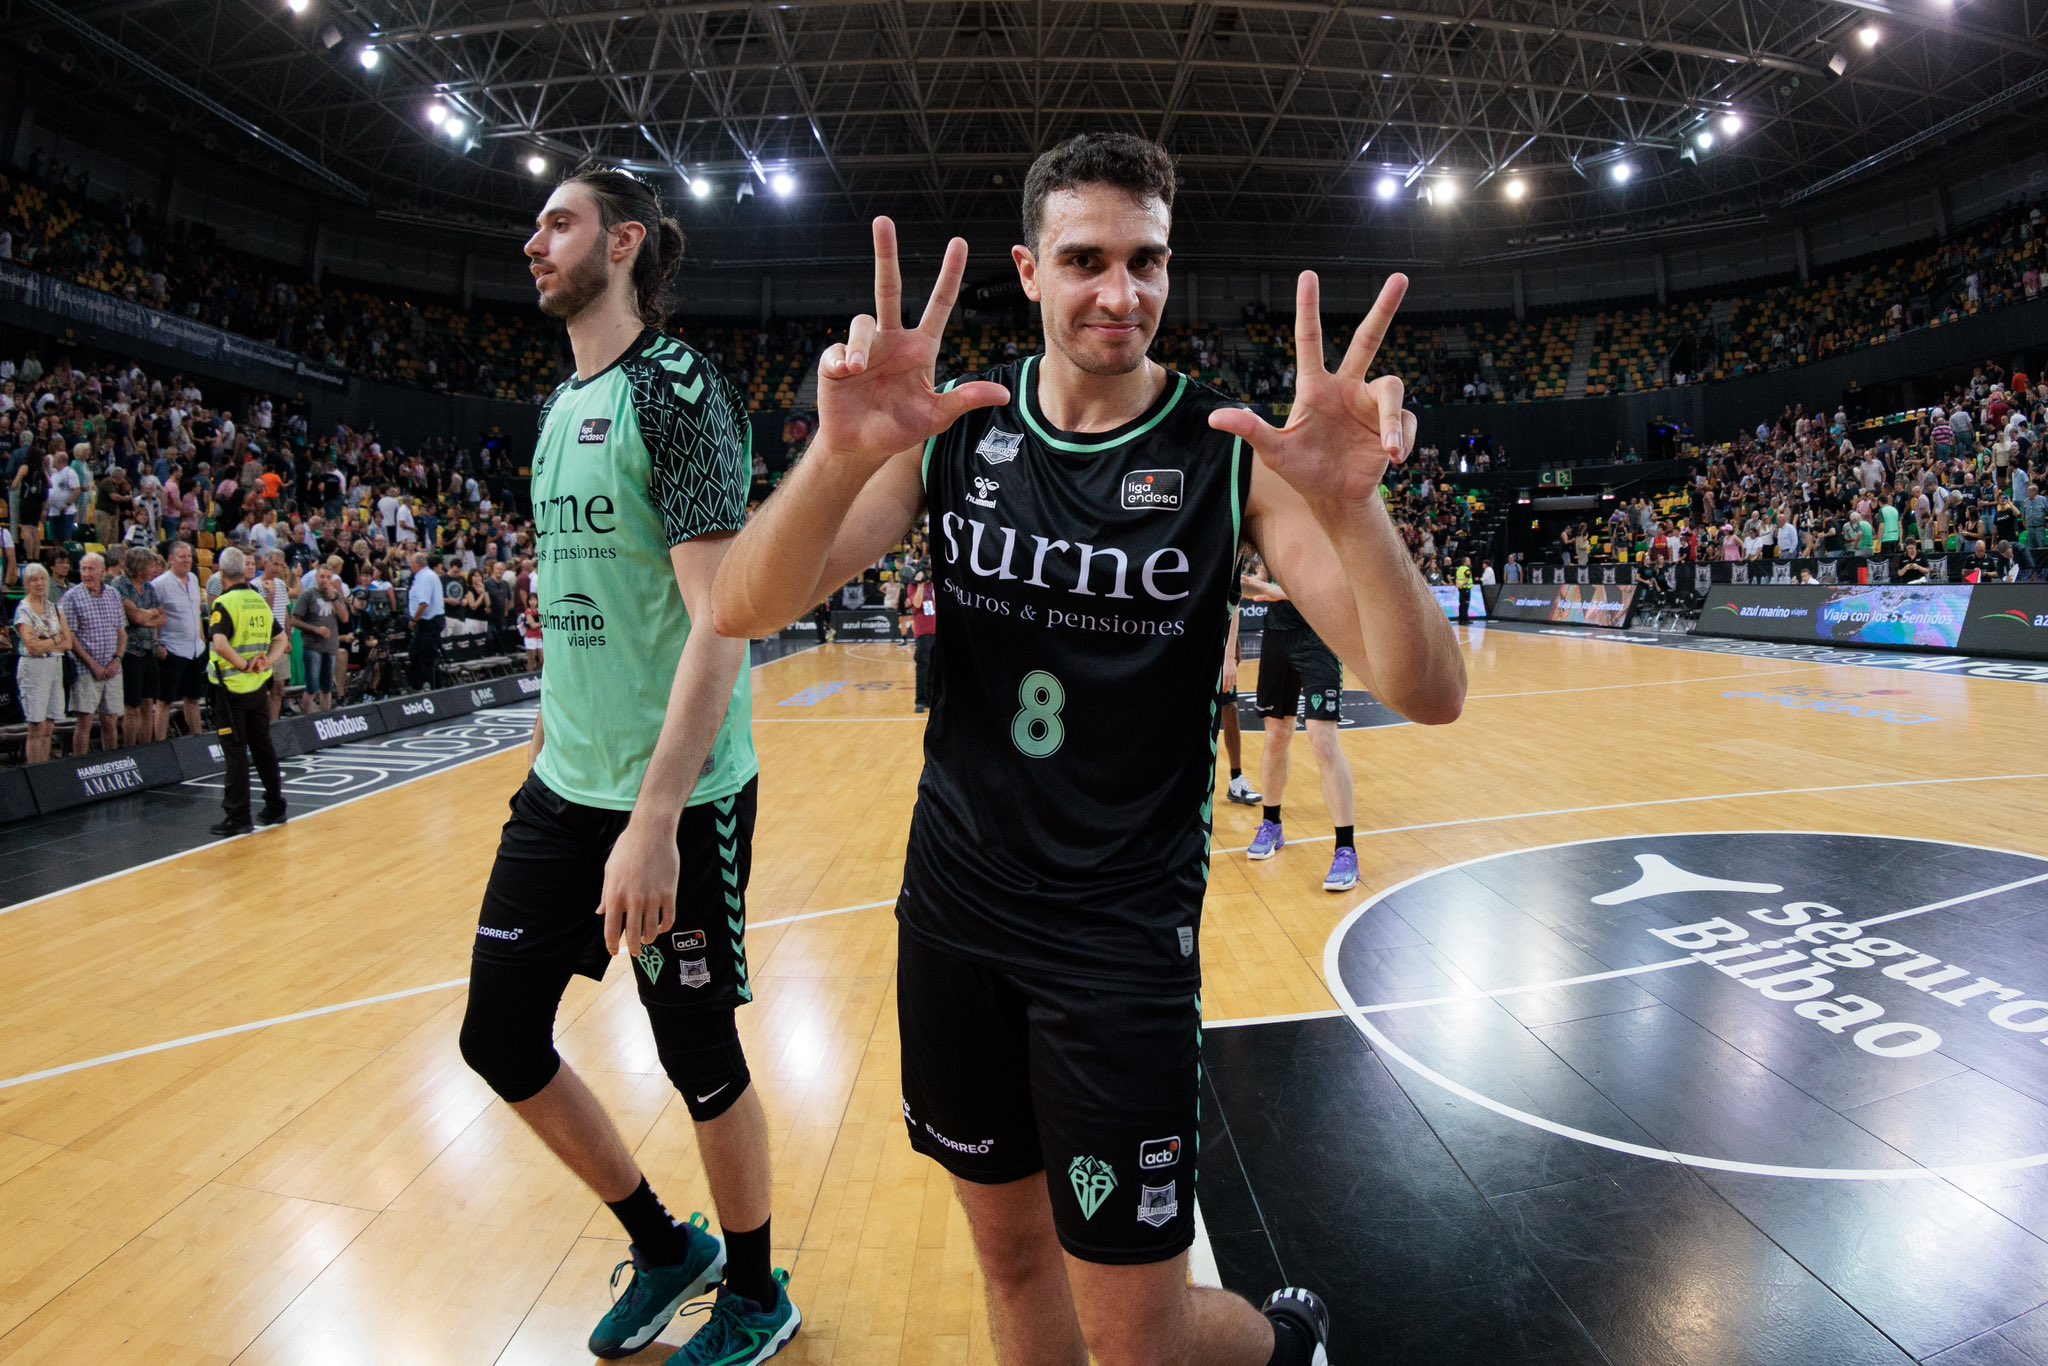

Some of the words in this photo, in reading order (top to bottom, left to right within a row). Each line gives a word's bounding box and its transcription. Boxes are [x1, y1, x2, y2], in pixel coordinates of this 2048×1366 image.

[580, 432, 605, 441] endesa
[1542, 472, 1551, 483] C
[1128, 481, 1152, 494] liga
[965, 492, 997, 509] hummel
[1127, 492, 1178, 505] endesa
[942, 511, 1190, 601] surne
[1740, 605, 1759, 617] azul
[1758, 605, 1790, 618] marino
[1790, 607, 1808, 617] viajes
[1823, 608, 1849, 623] Viaja
[1850, 612, 1870, 622] con
[1871, 610, 1889, 623] los
[1889, 611, 1899, 623] 5
[1899, 610, 1953, 625] Sentidos
[249, 615, 265, 628] 413
[842, 621, 860, 630] azul
[861, 619, 891, 629] marino
[1020, 604, 1037, 621] &
[1048, 608, 1185, 636] pensiones
[567, 634, 607, 649] viajes
[402, 702, 425, 716] bbk
[1011, 669, 1066, 759] 8
[314, 714, 369, 741] Bilbobus
[76, 756, 138, 778] HAMBUEYSERÍA
[82, 769, 145, 797] AMAREN
[480, 926, 519, 940] CORREO
[676, 938, 699, 949] acb
[1747, 901, 2048, 1046] seguro
[1646, 917, 1942, 1058] Bilbao
[936, 1132, 990, 1154] CORREO
[1145, 1149, 1173, 1165] acb
